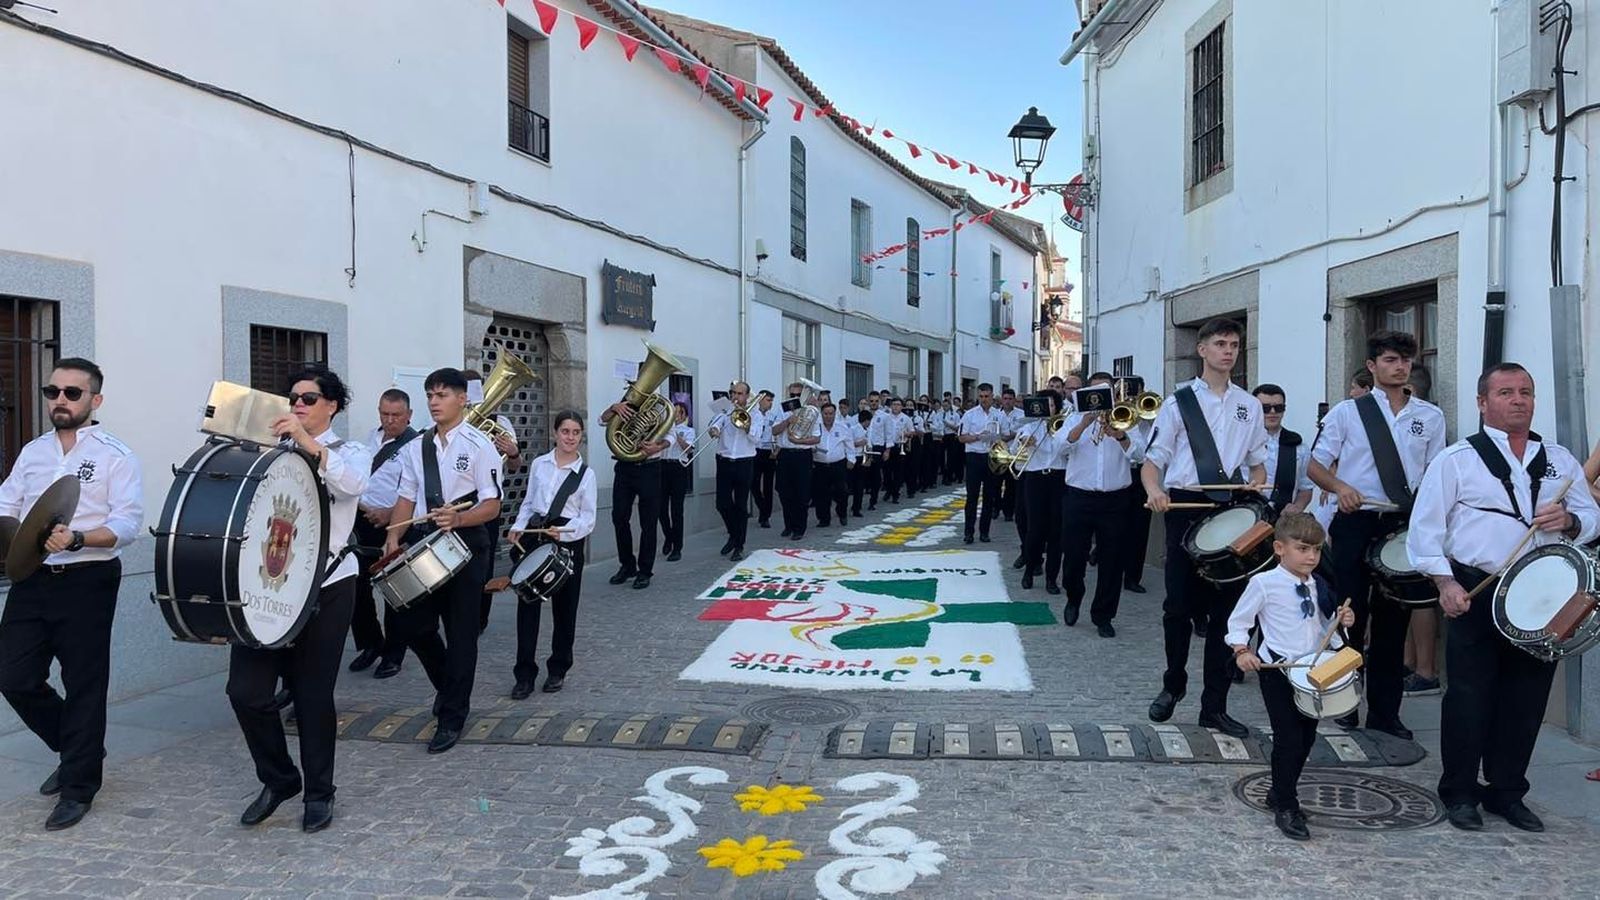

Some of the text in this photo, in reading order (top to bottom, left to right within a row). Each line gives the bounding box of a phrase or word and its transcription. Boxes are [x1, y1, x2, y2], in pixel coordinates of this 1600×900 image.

[706, 586, 823, 602] JMJ
[725, 580, 826, 594] LISBOA
[242, 590, 293, 618] DOS TORRES
[1520, 630, 1548, 640] TORRE
[728, 651, 873, 670] MEJOR
